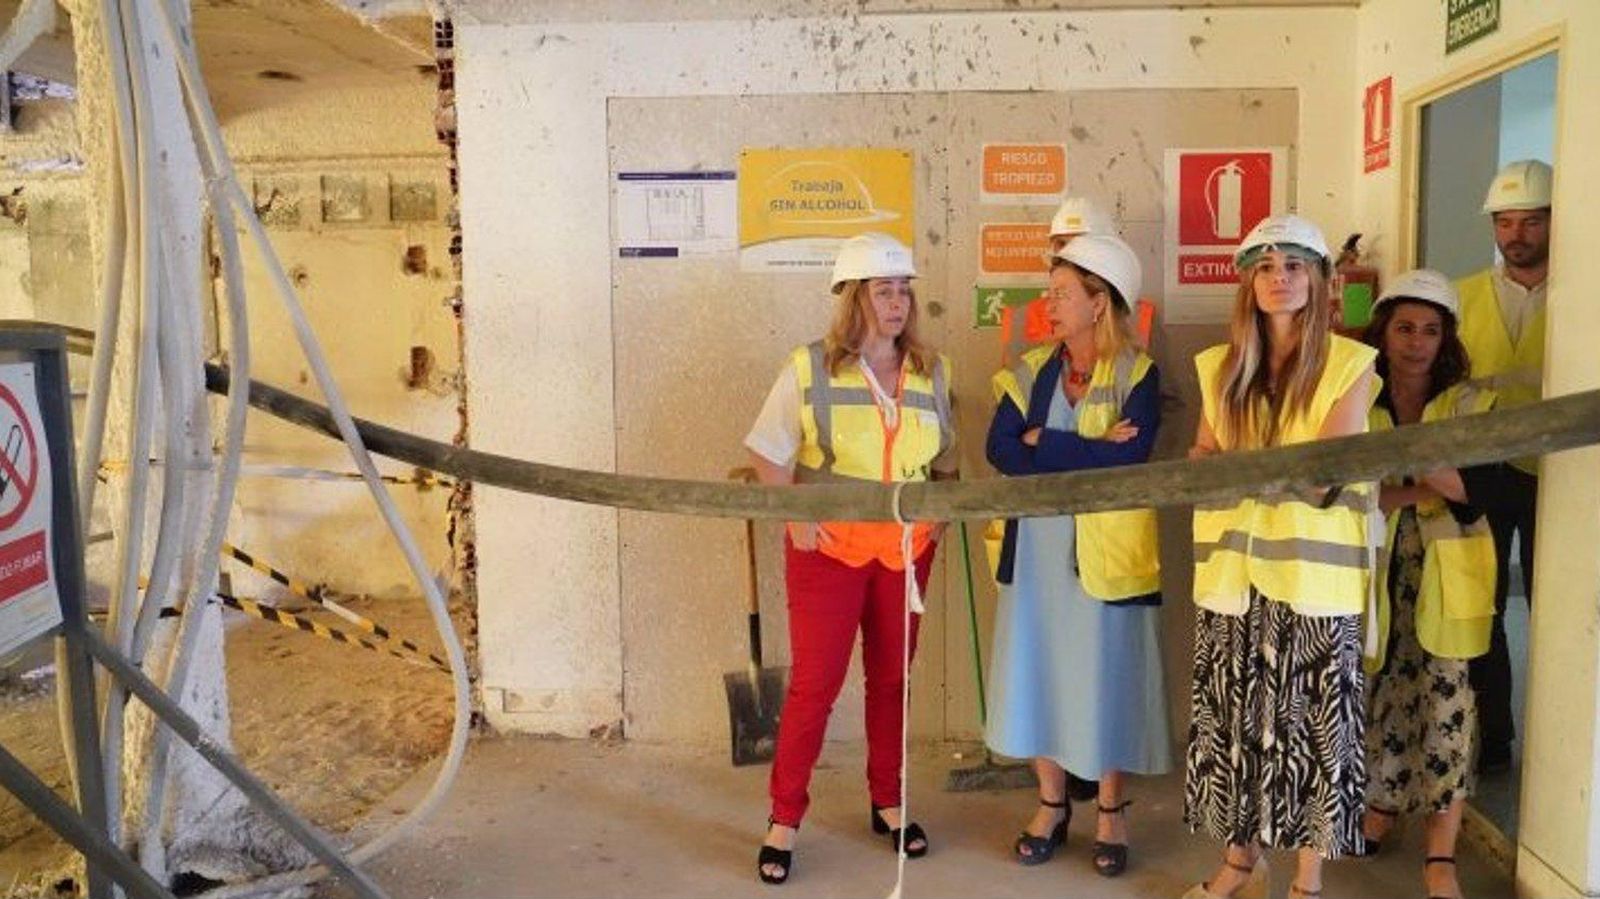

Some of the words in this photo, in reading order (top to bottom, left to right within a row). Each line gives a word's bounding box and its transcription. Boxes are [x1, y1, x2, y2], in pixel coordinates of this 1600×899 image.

[1001, 152, 1047, 165] RIESGO
[993, 172, 1055, 186] TROPIEZO
[790, 179, 844, 194] Trabaja
[769, 199, 796, 212] SIN
[799, 199, 866, 211] ALCOHOL
[1183, 262, 1235, 277] EXTIN
